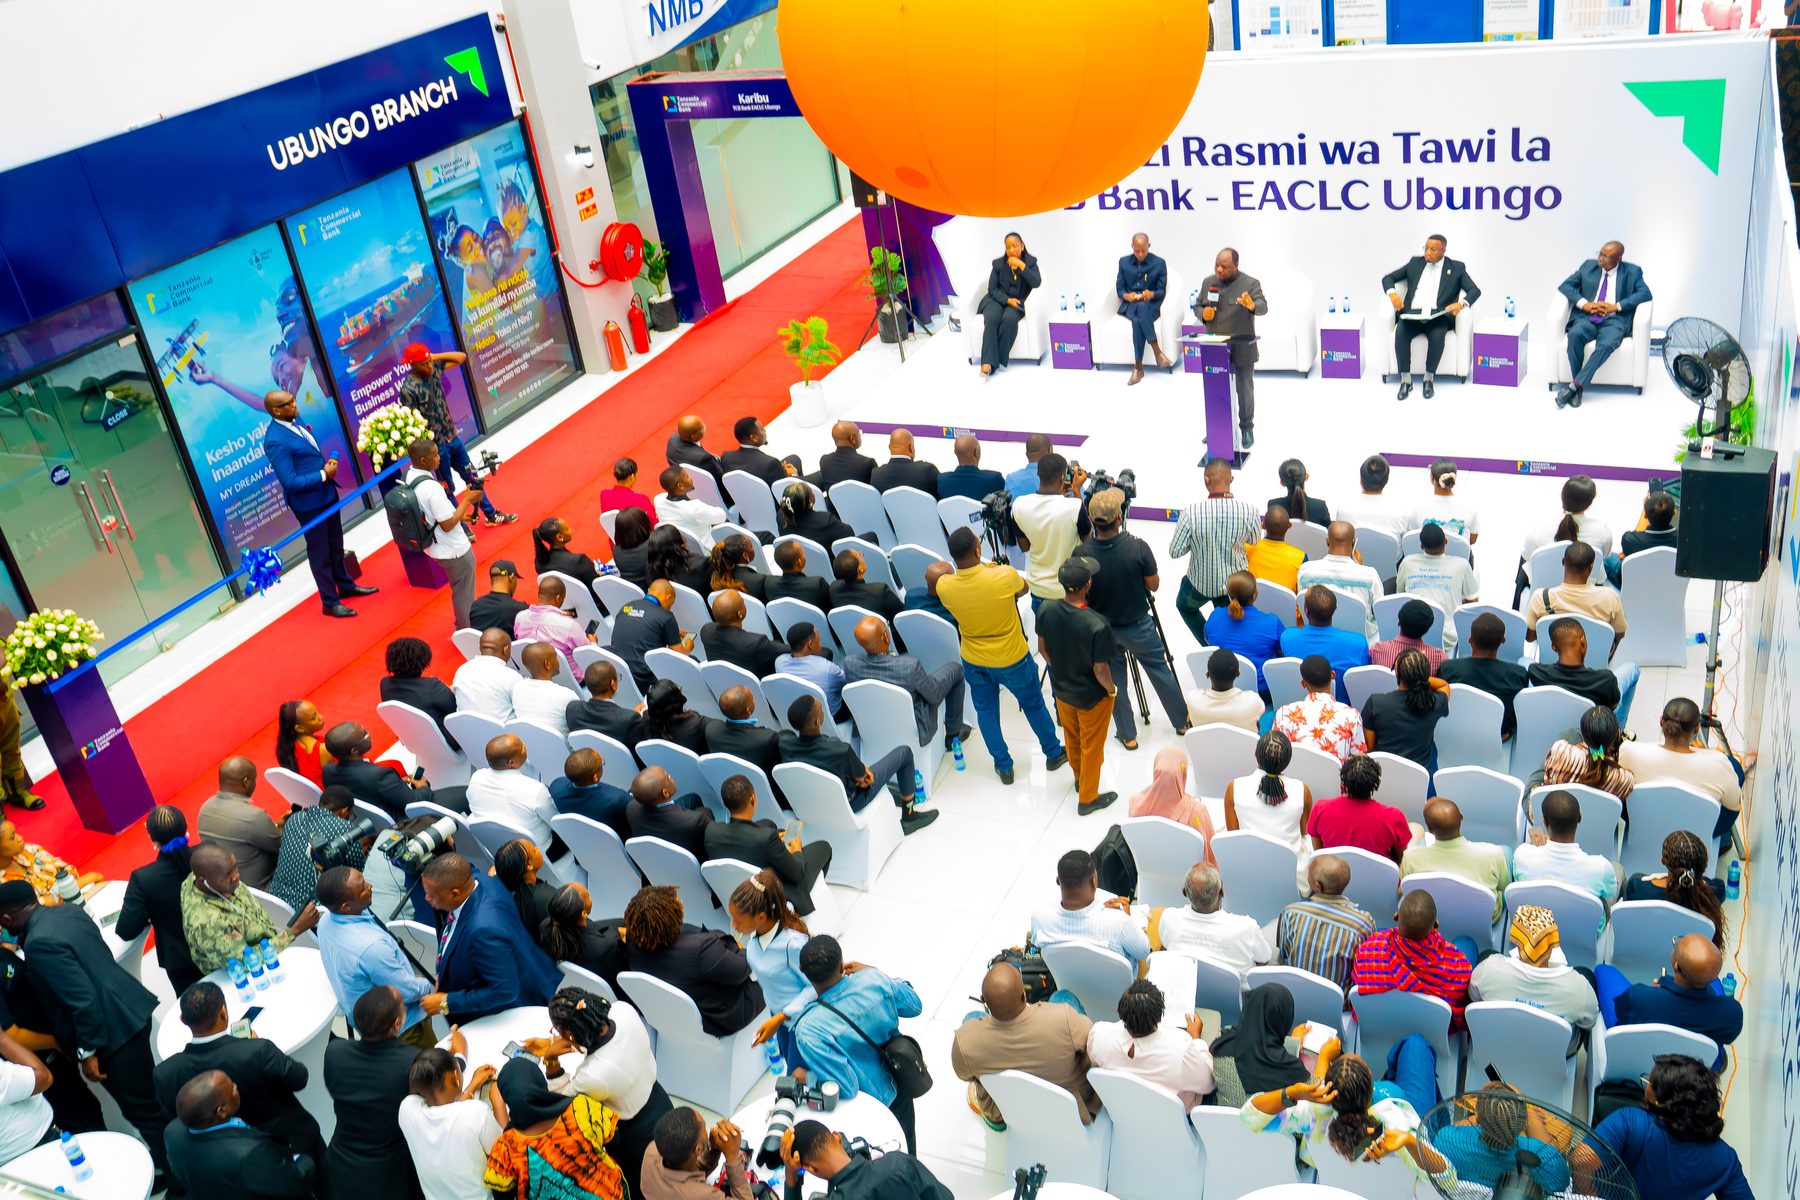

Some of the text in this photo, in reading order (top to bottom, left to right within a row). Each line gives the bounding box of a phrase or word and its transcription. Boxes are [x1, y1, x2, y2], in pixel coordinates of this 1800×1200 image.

[648, 0, 704, 36] NMB
[738, 92, 770, 104] Karibu
[267, 76, 458, 170] UBUNGO BRANCH
[1182, 132, 1307, 166] Rasmi
[1319, 140, 1380, 165] wa
[1392, 128, 1496, 164] Tawi
[1511, 126, 1550, 162] la
[1098, 179, 1195, 211] Bank
[1232, 180, 1370, 212] EACLC
[1383, 177, 1562, 220] Ubungo
[318, 207, 349, 224] Tanzania
[320, 209, 361, 232] Commercial
[322, 227, 340, 240] Bank
[168, 274, 200, 292] Tanzania
[170, 277, 214, 300] Commercial
[498, 280, 508, 293] na
[508, 269, 529, 288] ndoto
[173, 296, 191, 308] Bank
[478, 292, 508, 316] kumiliki
[507, 279, 536, 301] nyumba
[475, 334, 496, 351] Ndoto
[350, 370, 393, 402] Empower
[354, 388, 395, 416] Business
[107, 408, 129, 426] CLOSE
[205, 437, 246, 466] Kesho
[219, 486, 233, 501] MY
[234, 470, 263, 493] DREAM
[1774, 758, 1786, 891] Bank
[1778, 902, 1794, 1128] EACLC
